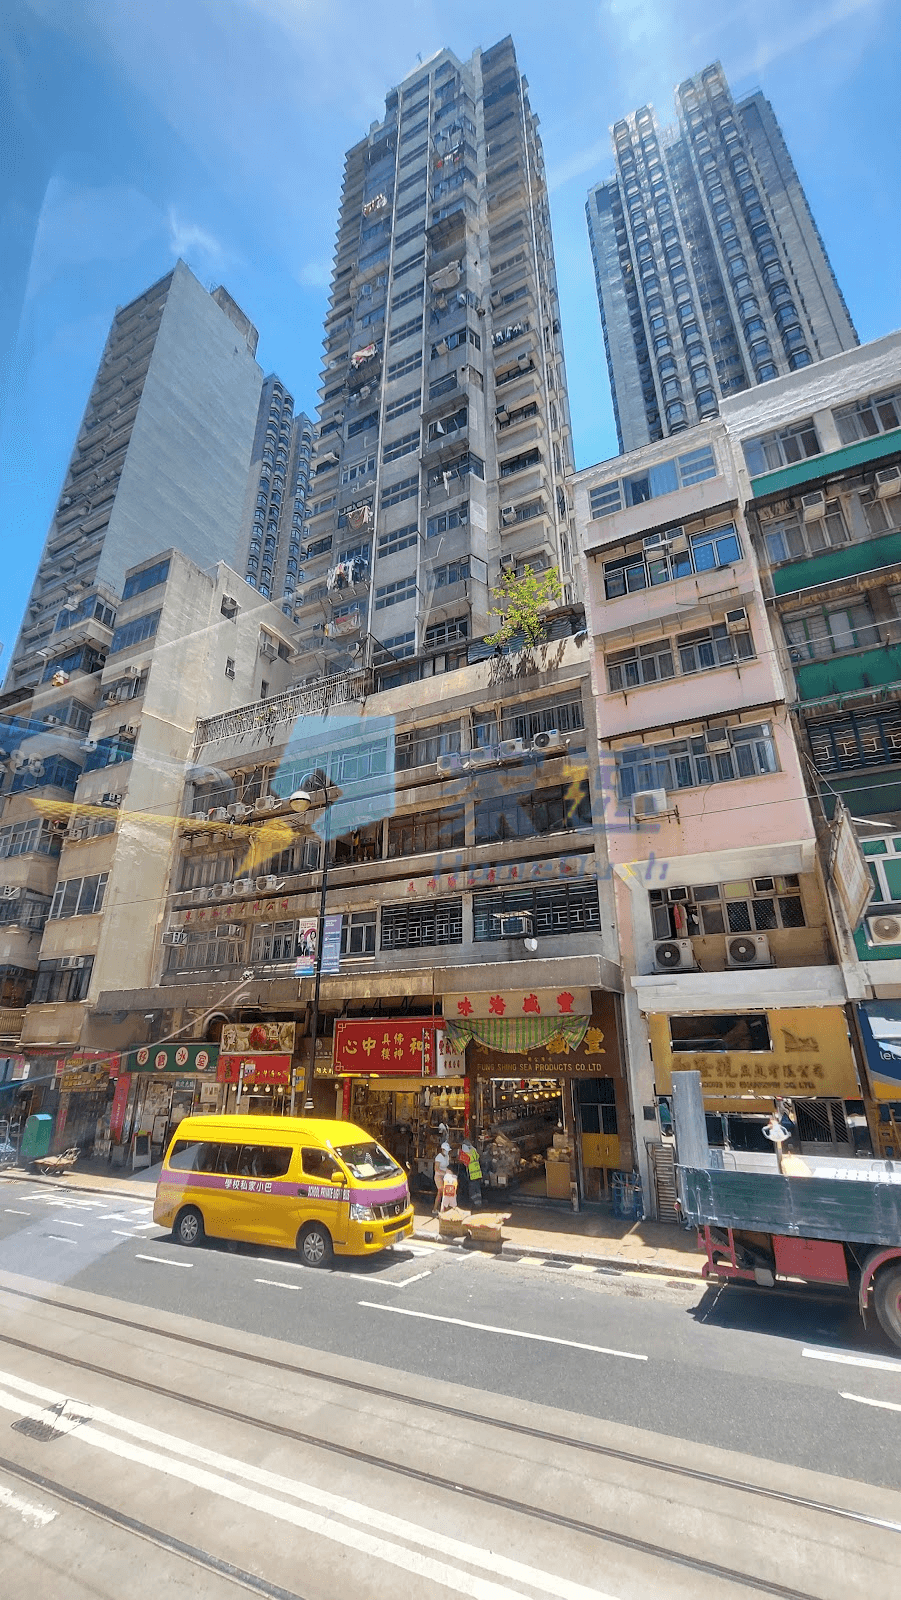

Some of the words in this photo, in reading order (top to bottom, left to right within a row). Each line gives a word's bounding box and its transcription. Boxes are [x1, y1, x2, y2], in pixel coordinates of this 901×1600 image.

[477, 1063, 495, 1071] FUNG
[497, 1063, 516, 1071] SHING
[519, 1063, 532, 1071] SEA
[535, 1063, 573, 1071] PRODUCTS
[224, 1178, 272, 1193] 學校私家小巴
[307, 1186, 320, 1198] SCHOOL
[320, 1186, 334, 1198] PRIVATE
[342, 1189, 350, 1200] BUS
